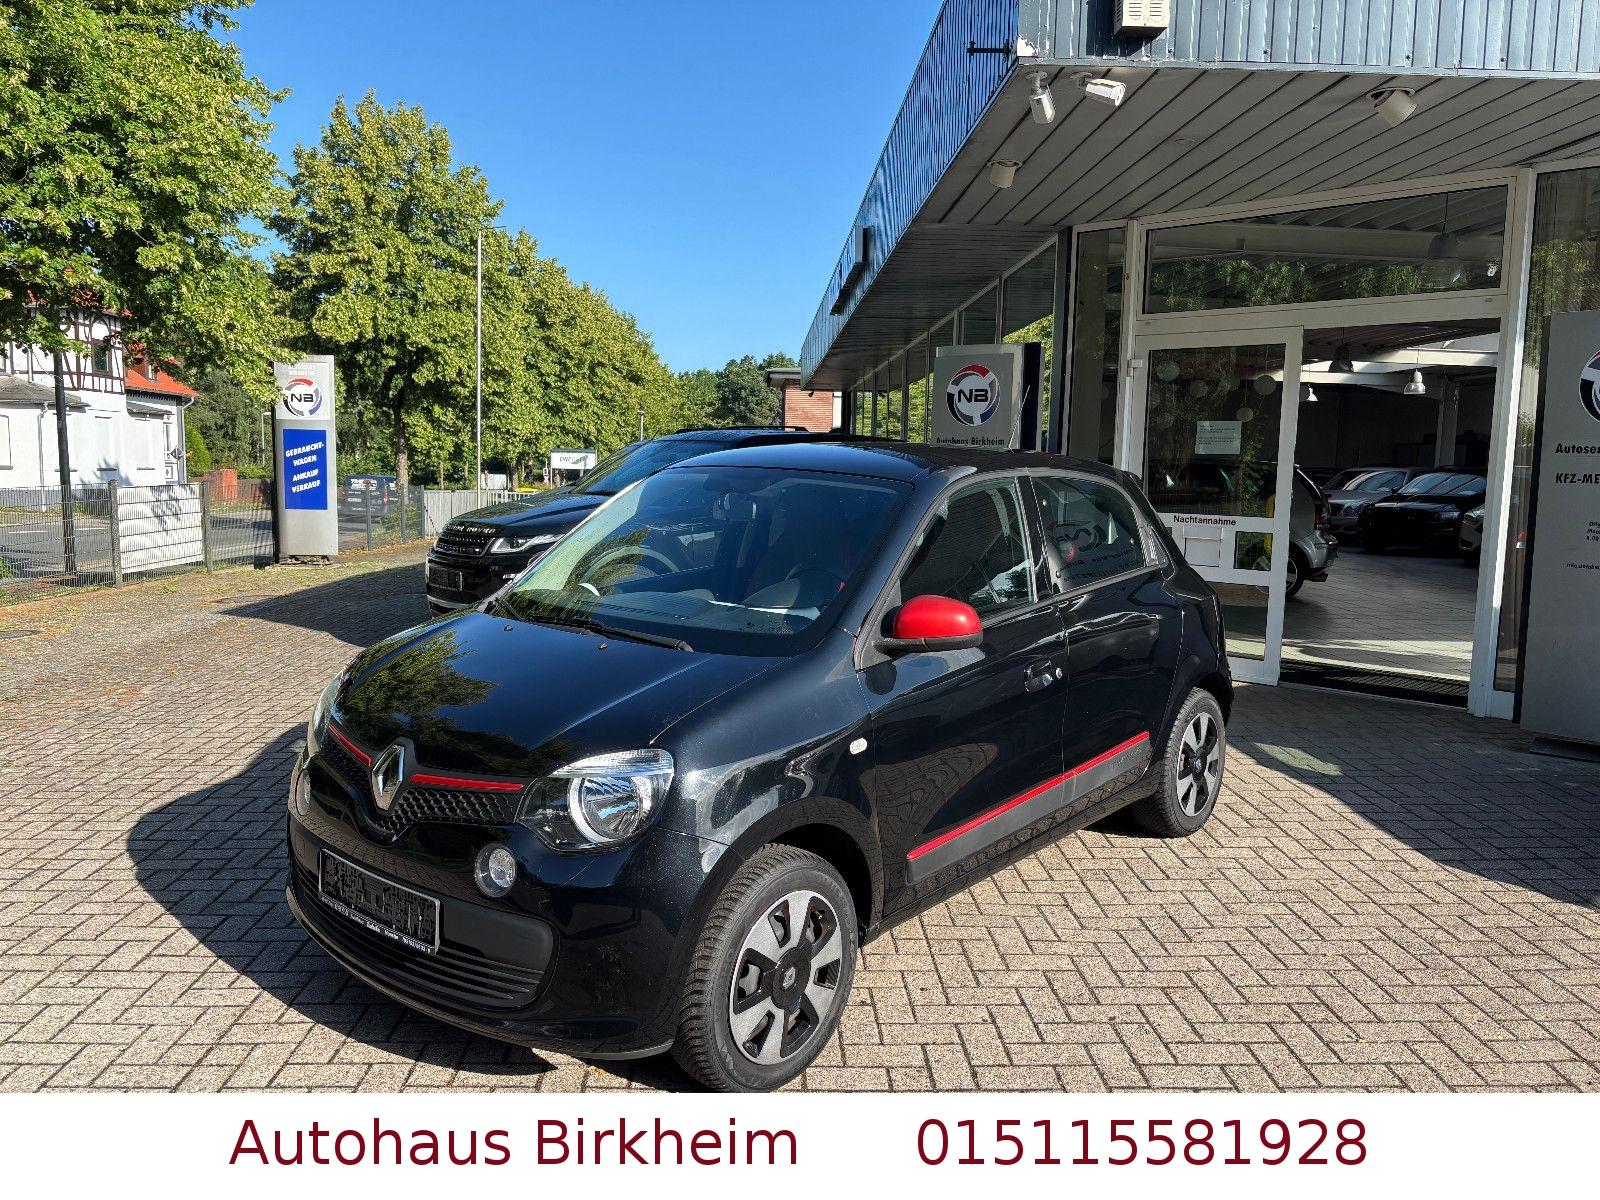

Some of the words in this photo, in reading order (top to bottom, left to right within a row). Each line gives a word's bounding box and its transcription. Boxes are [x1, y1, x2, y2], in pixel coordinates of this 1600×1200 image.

[290, 393, 314, 402] NB
[956, 388, 989, 403] NB
[971, 437, 1005, 446] Birkheim
[285, 441, 325, 457] GEBRAUCHT-
[292, 455, 317, 467] WAGEN
[292, 468, 319, 482] ANKAUF
[291, 480, 321, 493] VERKAUF
[1173, 515, 1237, 526] Nachtannahme
